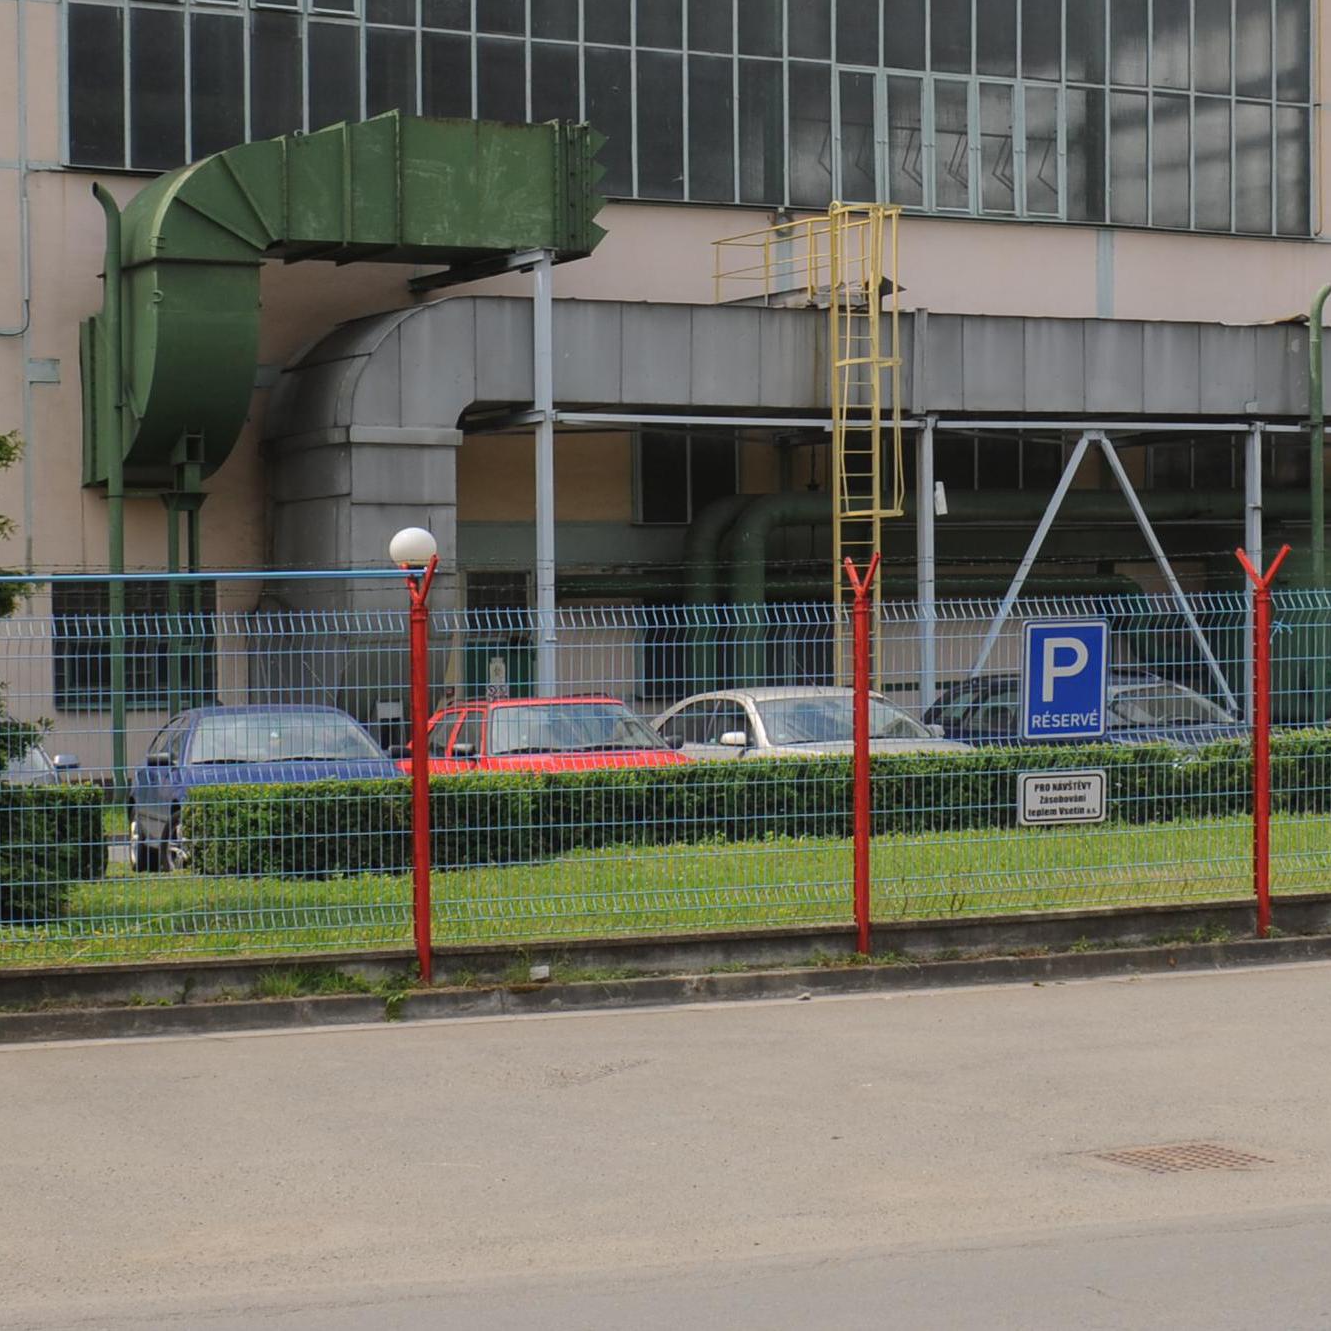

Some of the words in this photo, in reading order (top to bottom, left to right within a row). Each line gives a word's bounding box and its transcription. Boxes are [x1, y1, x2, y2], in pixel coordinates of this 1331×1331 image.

[1042, 637, 1088, 702] P
[1032, 709, 1099, 728] RÉSERVÉ
[1035, 783, 1050, 792] PRO
[1028, 809, 1057, 817] teplem
